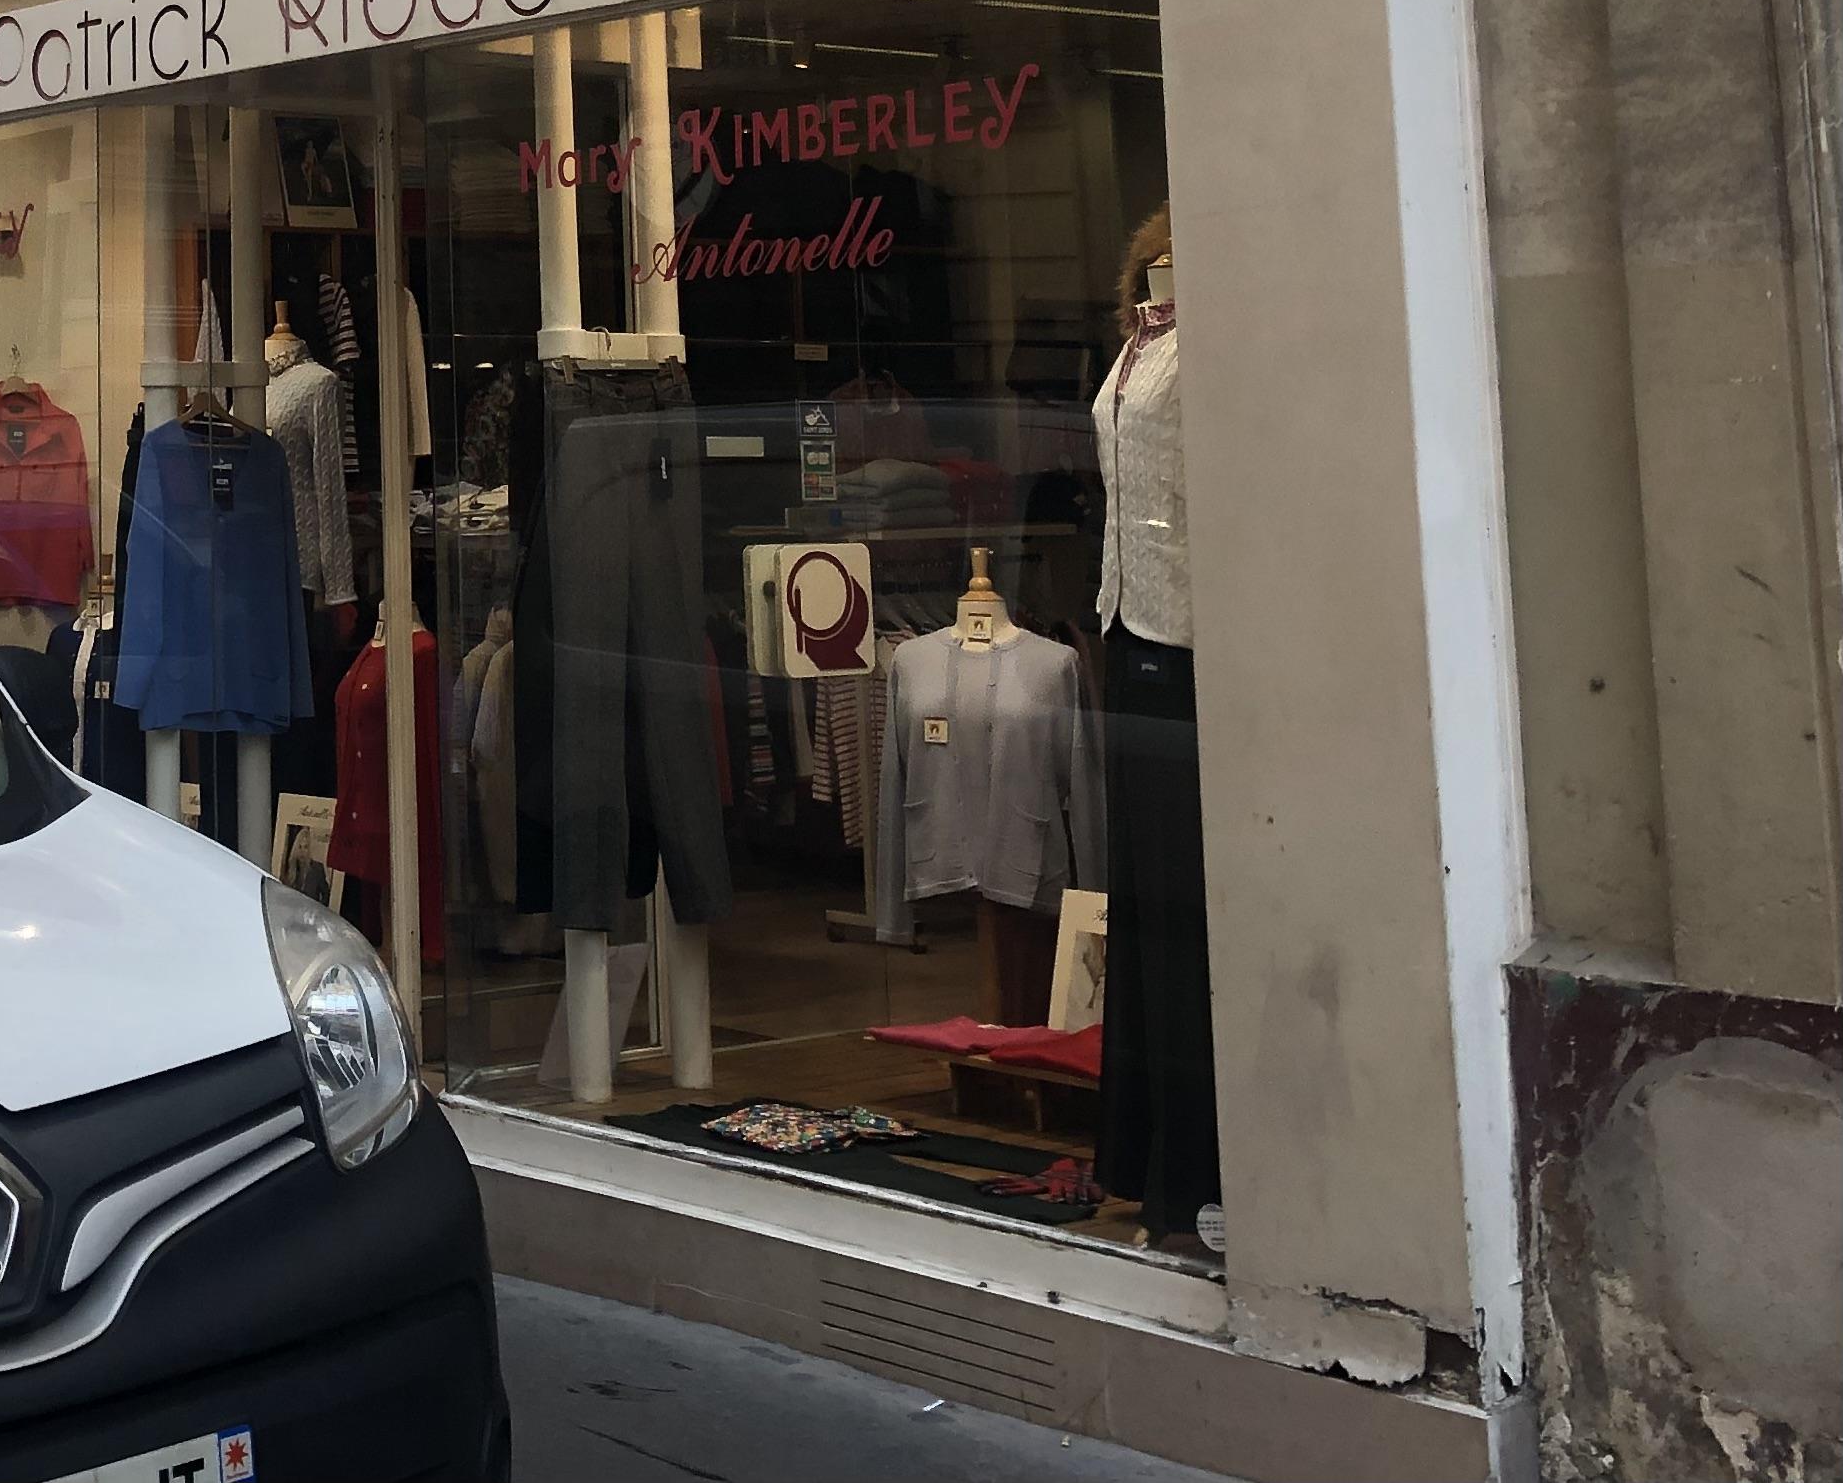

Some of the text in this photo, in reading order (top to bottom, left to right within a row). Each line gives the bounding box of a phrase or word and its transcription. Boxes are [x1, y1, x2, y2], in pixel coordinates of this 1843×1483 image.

[518, 63, 1040, 194] Mary KIMBERLEY
[631, 195, 895, 285] Antonelle
